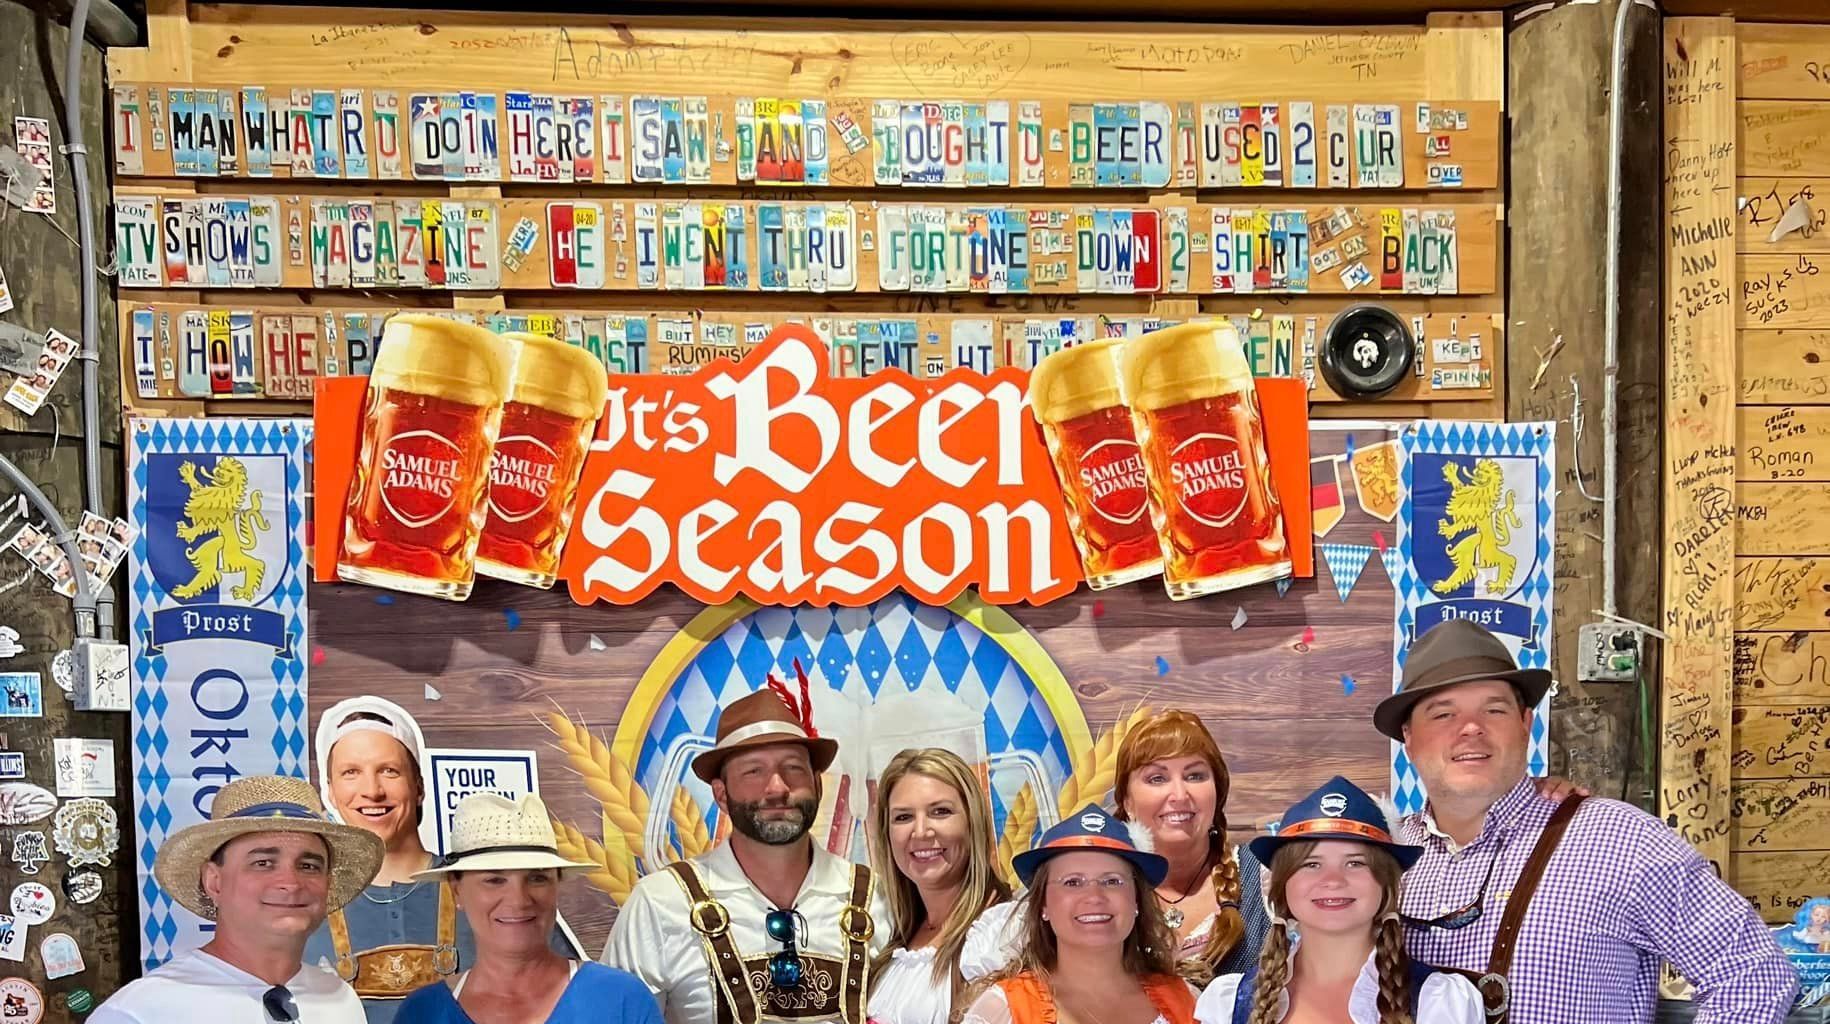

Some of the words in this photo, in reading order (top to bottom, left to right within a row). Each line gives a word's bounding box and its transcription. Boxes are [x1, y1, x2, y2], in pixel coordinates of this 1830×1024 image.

[1697, 78, 1725, 92] here
[173, 111, 236, 158] MAN
[244, 111, 334, 155] WHAT
[344, 109, 366, 155] R
[378, 114, 399, 157] U
[512, 113, 593, 162] HERE
[607, 120, 621, 161] I
[642, 120, 709, 163] SAW
[738, 122, 826, 163] BAND
[883, 120, 1008, 167] BOUGHT
[1071, 121, 1163, 164] BEER
[1203, 123, 1278, 166] USED
[1293, 121, 1313, 165] 2
[1329, 131, 1345, 167] C
[1357, 128, 1395, 168] UR
[1428, 137, 1449, 151] ALL
[1430, 166, 1462, 179] OVER
[1668, 148, 1706, 175] Danny
[1703, 168, 1720, 185] up
[1672, 186, 1702, 203] here
[118, 222, 156, 265] TV
[165, 216, 270, 265] SHOWS
[312, 220, 488, 269] MAGAZINE
[557, 229, 595, 268] HE
[640, 228, 655, 266] I
[664, 226, 745, 268] WENT
[763, 227, 845, 270] THRU
[890, 227, 1028, 279] FORTUNE
[1033, 234, 1073, 253] LIKE
[1078, 230, 1151, 272] DOWN
[1170, 232, 1187, 271] 2
[1192, 236, 1207, 247] the
[1215, 232, 1303, 275] SHIRT
[1382, 234, 1453, 275] BACK
[1680, 249, 1719, 279] ANN
[1679, 279, 1720, 303] 2020
[1759, 300, 1789, 324] 2023
[665, 330, 690, 342] BUT
[706, 327, 733, 340] HEY
[187, 331, 254, 380] HOW
[268, 332, 316, 377] HE
[928, 362, 943, 375] ON
[705, 337, 1032, 494] Beer
[382, 447, 463, 483] SAMUEL
[1170, 449, 1248, 485] SAMUEL
[1747, 446, 1815, 470] Roman
[383, 468, 455, 500] ADAMS
[489, 469, 548, 499] ADAMS
[1090, 469, 1147, 502] ADAMS
[1180, 468, 1245, 500] ADAMS
[580, 468, 1060, 595] Season
[182, 611, 253, 634] Prost
[445, 767, 497, 788] YOUR
